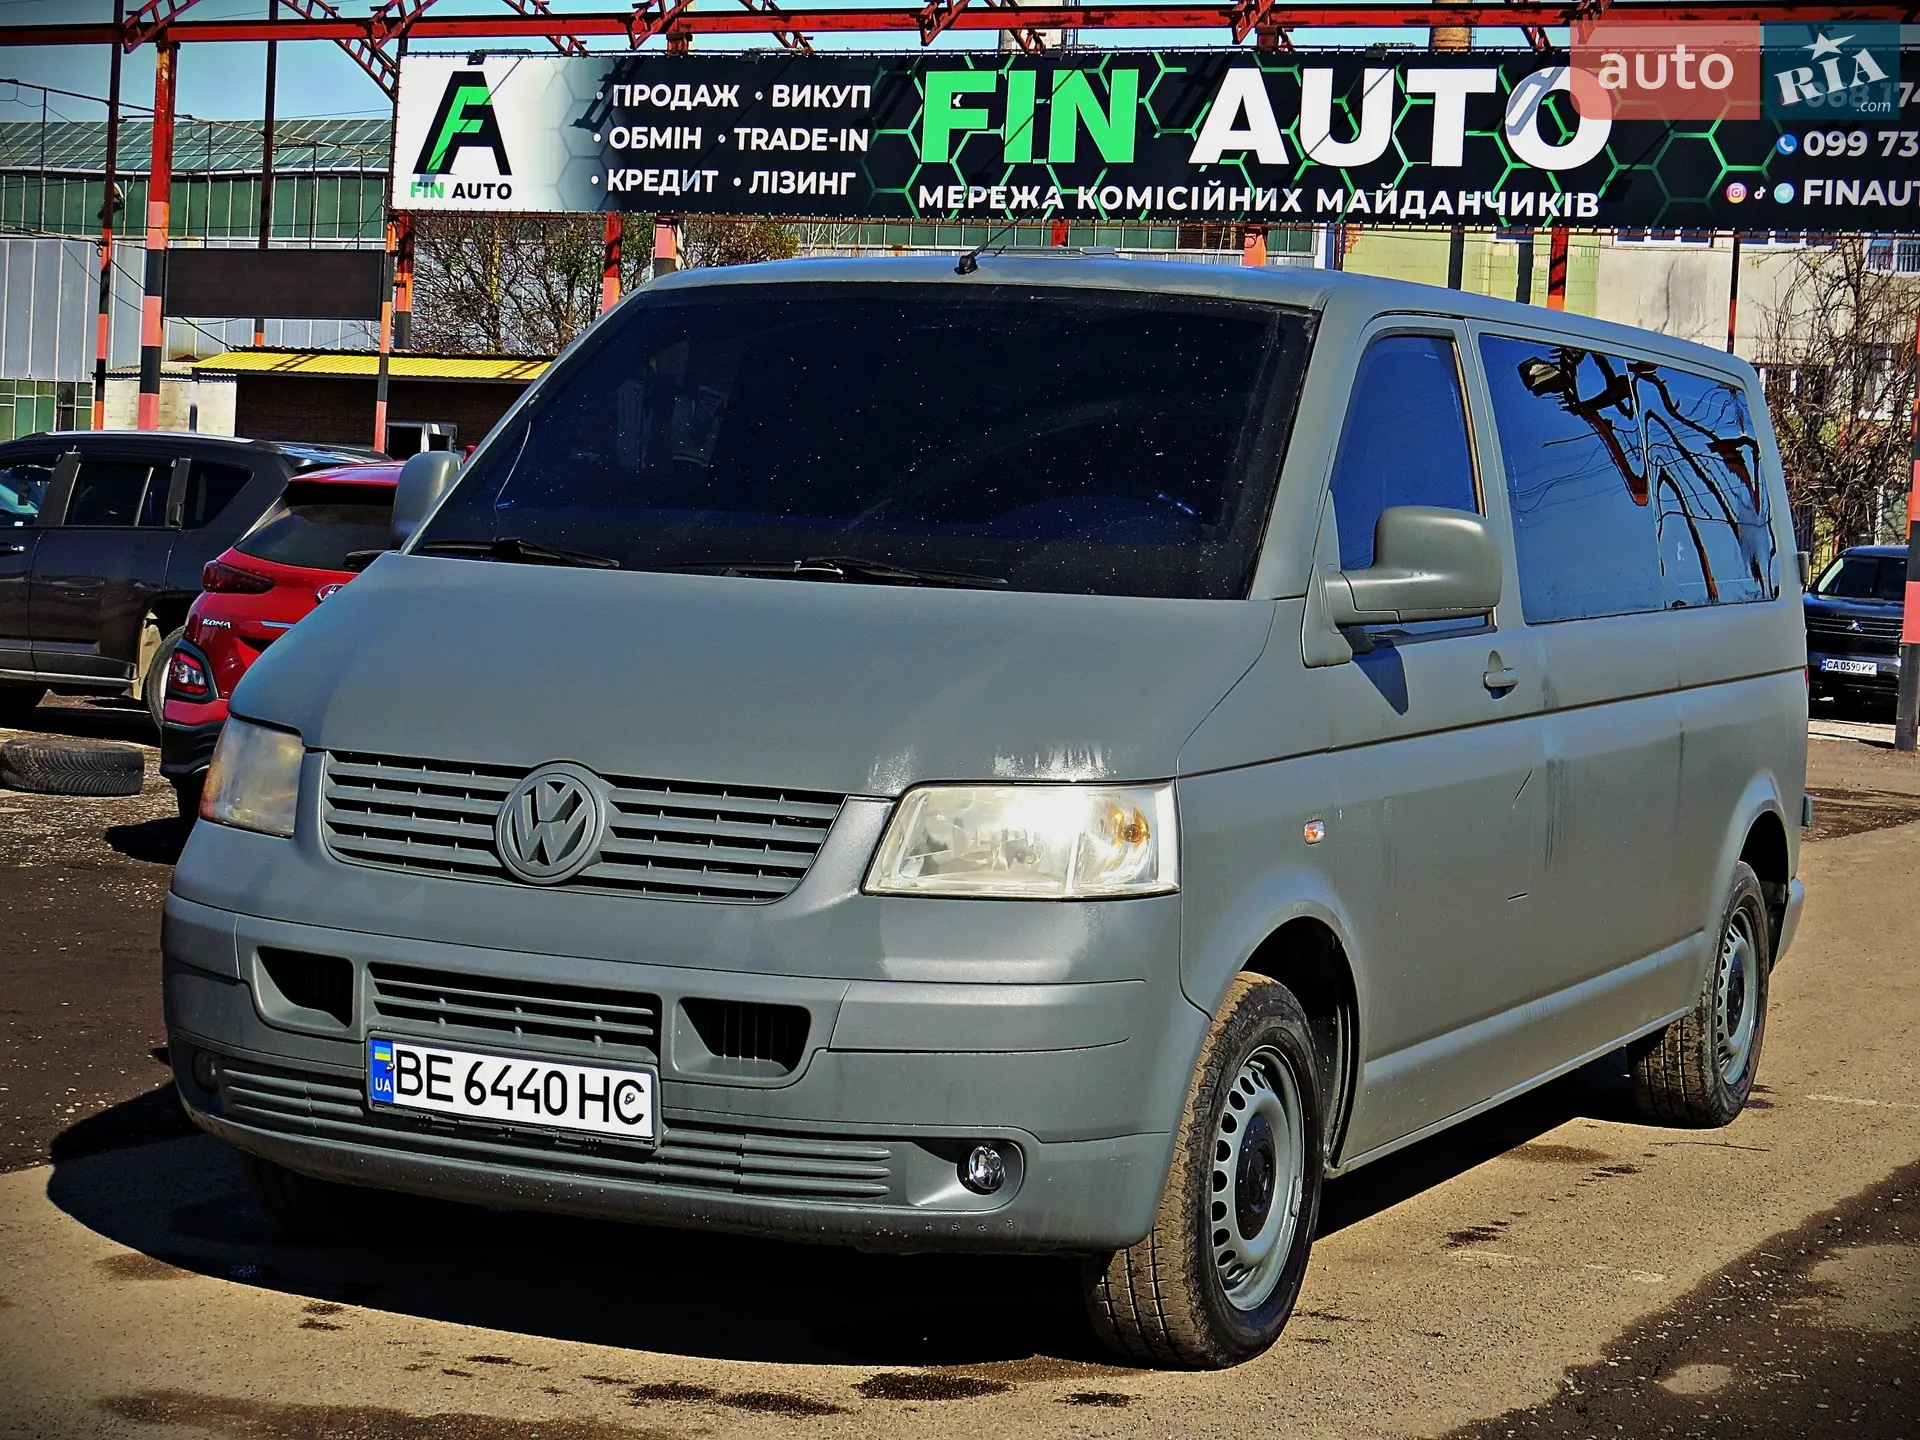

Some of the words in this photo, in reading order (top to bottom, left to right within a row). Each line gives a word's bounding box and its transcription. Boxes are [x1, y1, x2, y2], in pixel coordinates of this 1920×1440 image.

[612, 84, 740, 110] ПРОДАЖ
[772, 85, 871, 109] ВИКУП
[920, 68, 1139, 164] FIN
[1188, 67, 1613, 171] AUTO
[609, 127, 702, 150] ОБМІН
[733, 128, 869, 152] TRADE-IN
[1803, 130, 1868, 157] 099
[410, 182, 444, 199] FIN
[451, 183, 513, 200] AUTO
[607, 168, 719, 196] КРЕДИТ
[748, 170, 857, 195] ЛІЗИНГ
[918, 186, 1065, 210] МЕРЕЖА
[1077, 181, 1303, 213] КОМІСІЙНИХ
[1316, 183, 1599, 220] МАЙДАНЧИКІВ
[375, 1077, 392, 1094] UA
[396, 1049, 453, 1103] BE
[464, 1060, 568, 1117] 6440
[579, 1073, 645, 1126] HC
